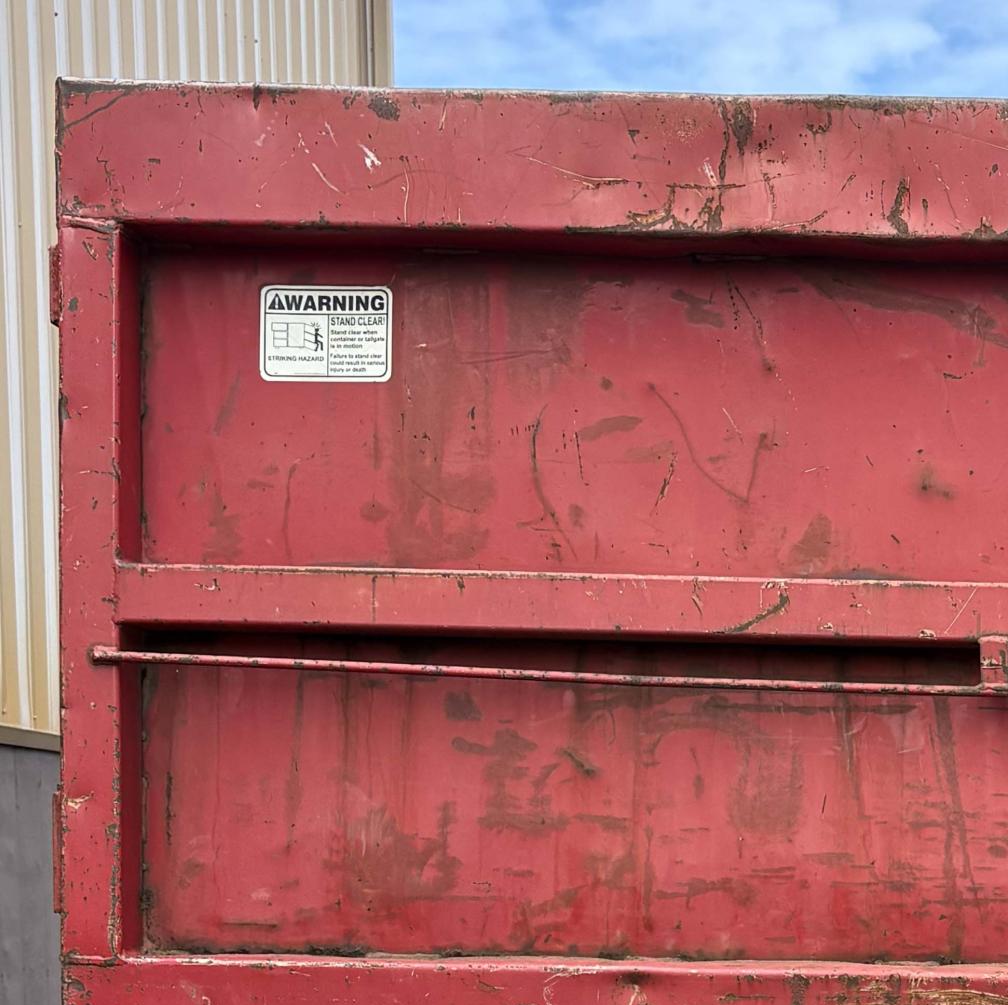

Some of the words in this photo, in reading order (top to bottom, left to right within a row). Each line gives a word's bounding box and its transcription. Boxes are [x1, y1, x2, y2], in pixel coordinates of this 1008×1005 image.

[284, 294, 385, 312] WARNING
[330, 316, 356, 326] STAND
[357, 316, 386, 326] CLEAR!
